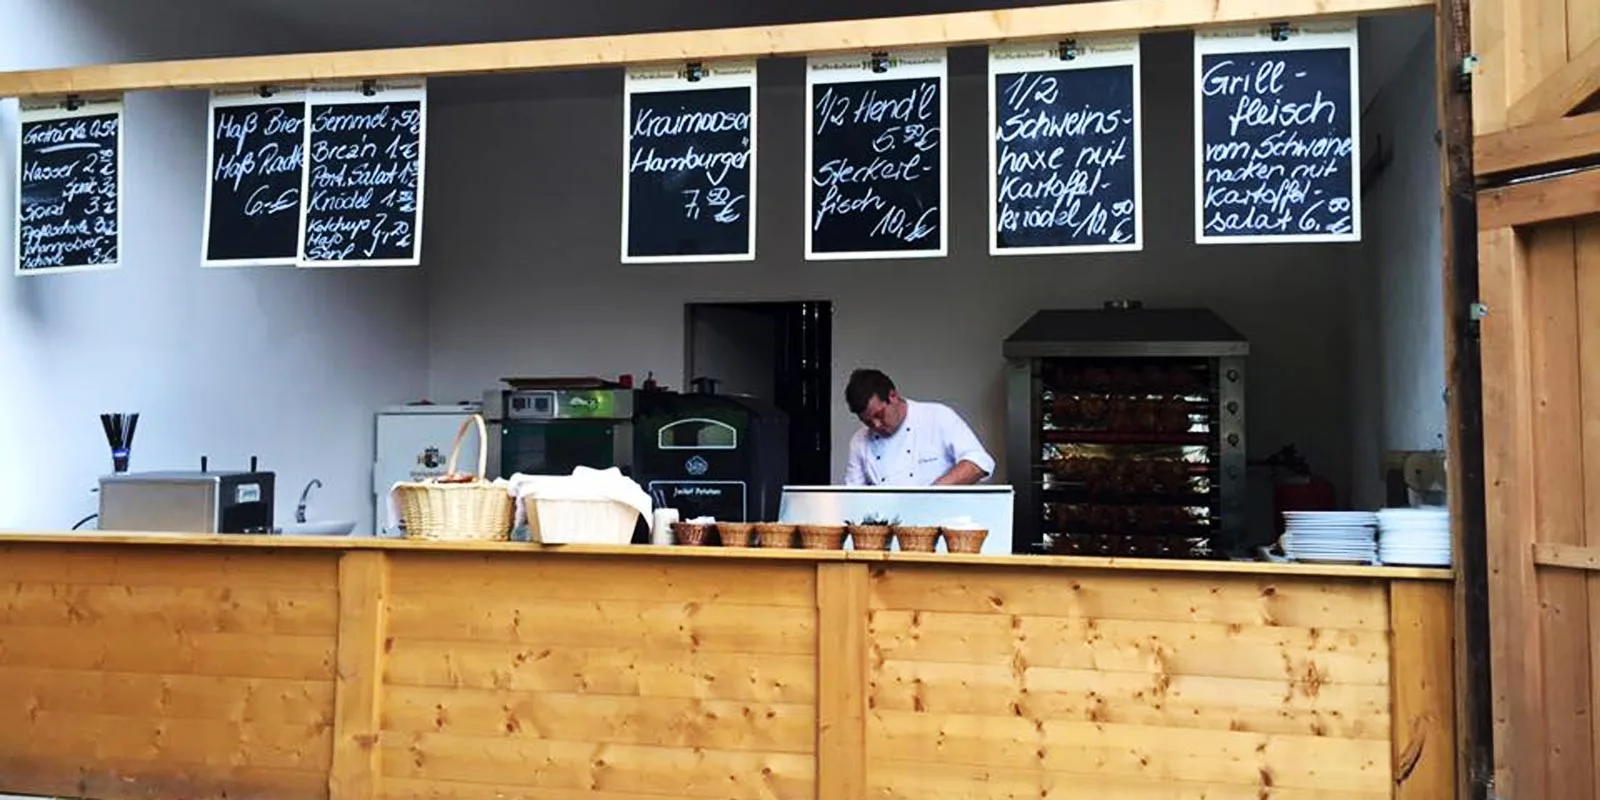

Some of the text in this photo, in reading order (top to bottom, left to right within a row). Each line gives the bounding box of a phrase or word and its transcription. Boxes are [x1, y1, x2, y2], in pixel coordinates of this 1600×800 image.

[1005, 73, 1059, 110] 1/2
[264, 107, 305, 136] Bier
[311, 105, 390, 133] Semmel
[816, 87, 850, 135] 1/2
[996, 105, 1133, 142] Schweins-
[1229, 90, 1336, 136] fleisch
[23, 121, 87, 144] Getränke
[998, 137, 1127, 175] haxe mit
[1206, 141, 1251, 162] vom
[22, 160, 80, 182] Wasser
[1206, 157, 1339, 183] nacken mit
[306, 187, 374, 214] Knödel
[814, 185, 886, 231] fisch
[307, 215, 371, 240] Ketchup
[1205, 206, 1293, 233] salat
[304, 243, 356, 260] Senf
